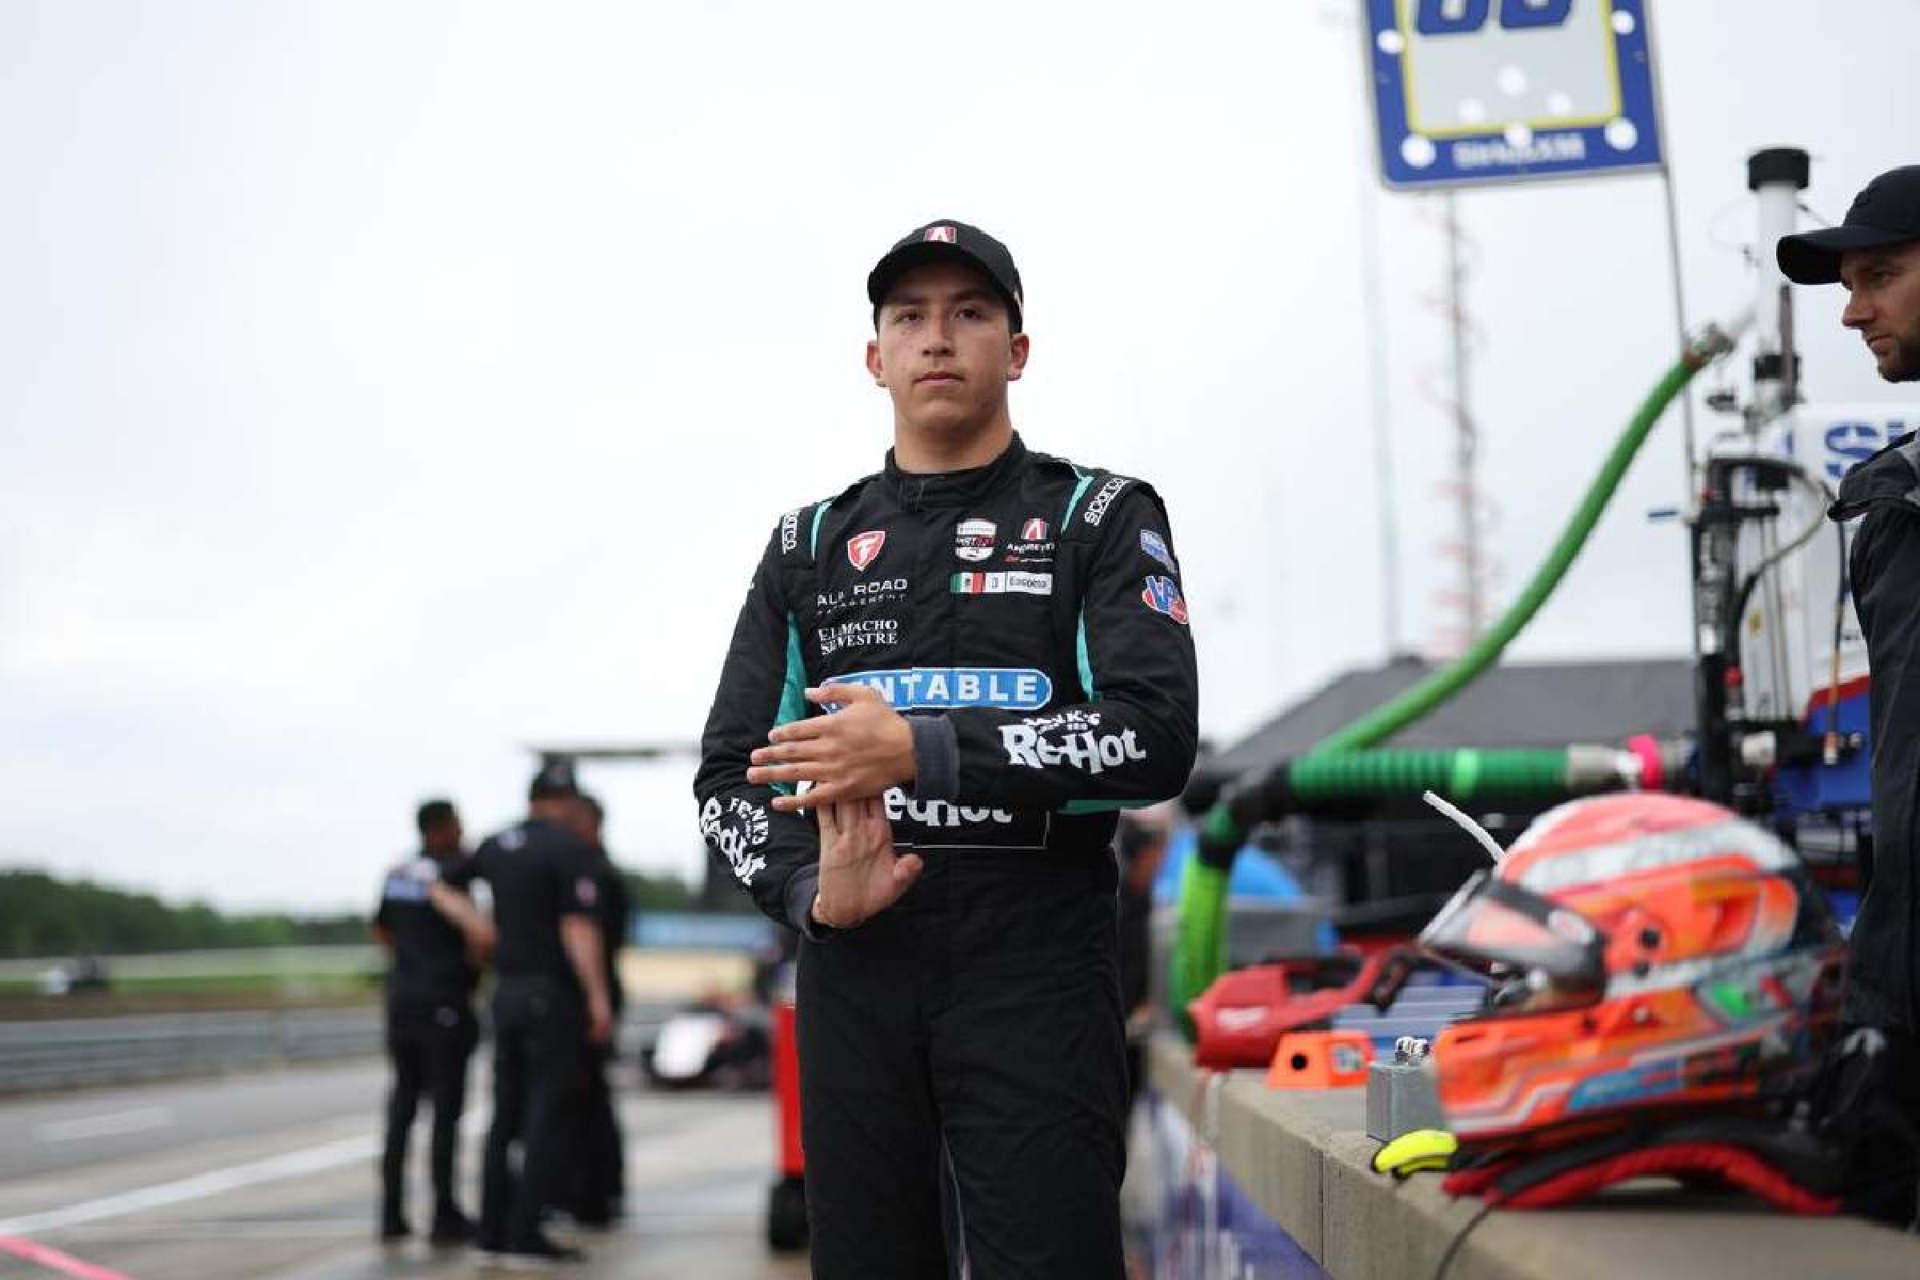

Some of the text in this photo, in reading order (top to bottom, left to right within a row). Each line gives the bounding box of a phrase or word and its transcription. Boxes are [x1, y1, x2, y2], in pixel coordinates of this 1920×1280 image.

[853, 578, 908, 595] ROAD
[839, 620, 898, 635] MACHO
[856, 674, 1038, 703] NTABLE
[998, 724, 1147, 774] ReHot
